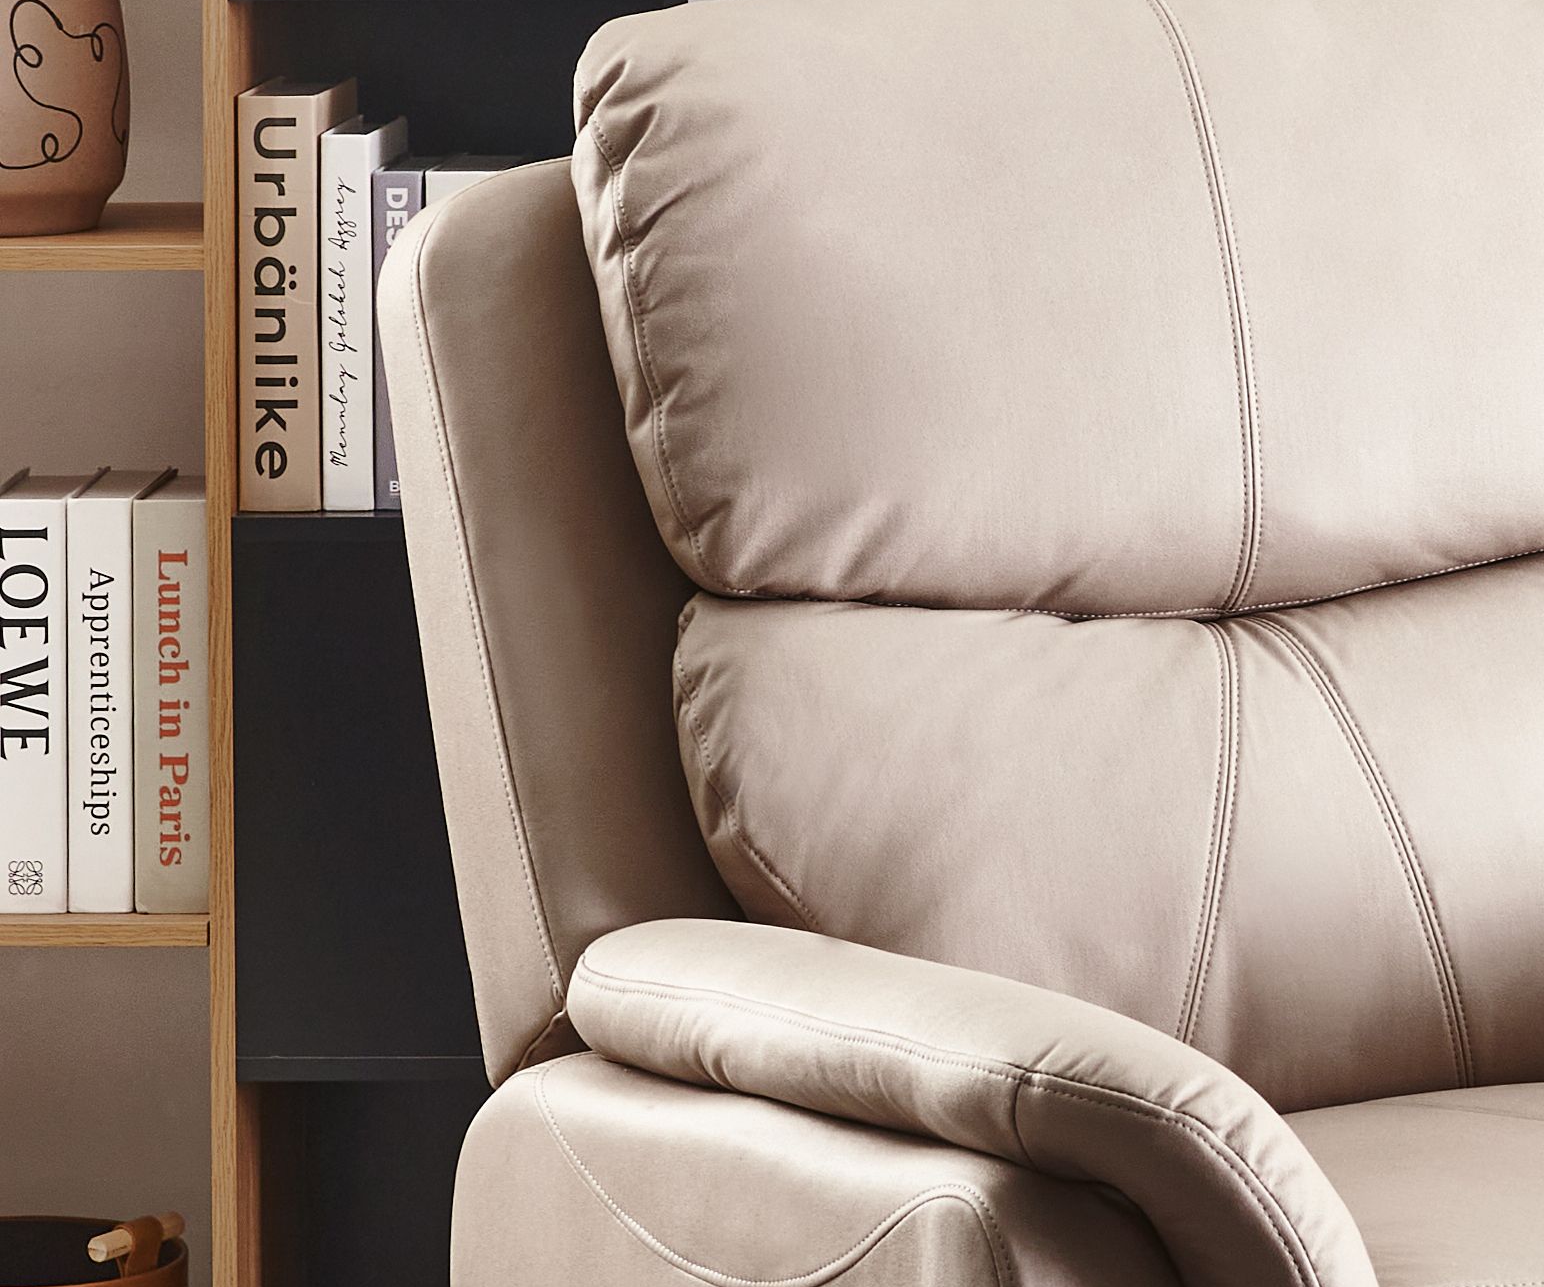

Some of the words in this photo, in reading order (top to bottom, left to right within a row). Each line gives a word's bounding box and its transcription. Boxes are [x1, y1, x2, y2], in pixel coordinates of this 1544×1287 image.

[254, 117, 299, 480] Urbänlike
[0, 526, 49, 760] LOEWE
[82, 567, 117, 836] Apprenticeships
[157, 549, 190, 686] Lunch
[159, 699, 191, 739] in
[159, 752, 192, 867] Paris
